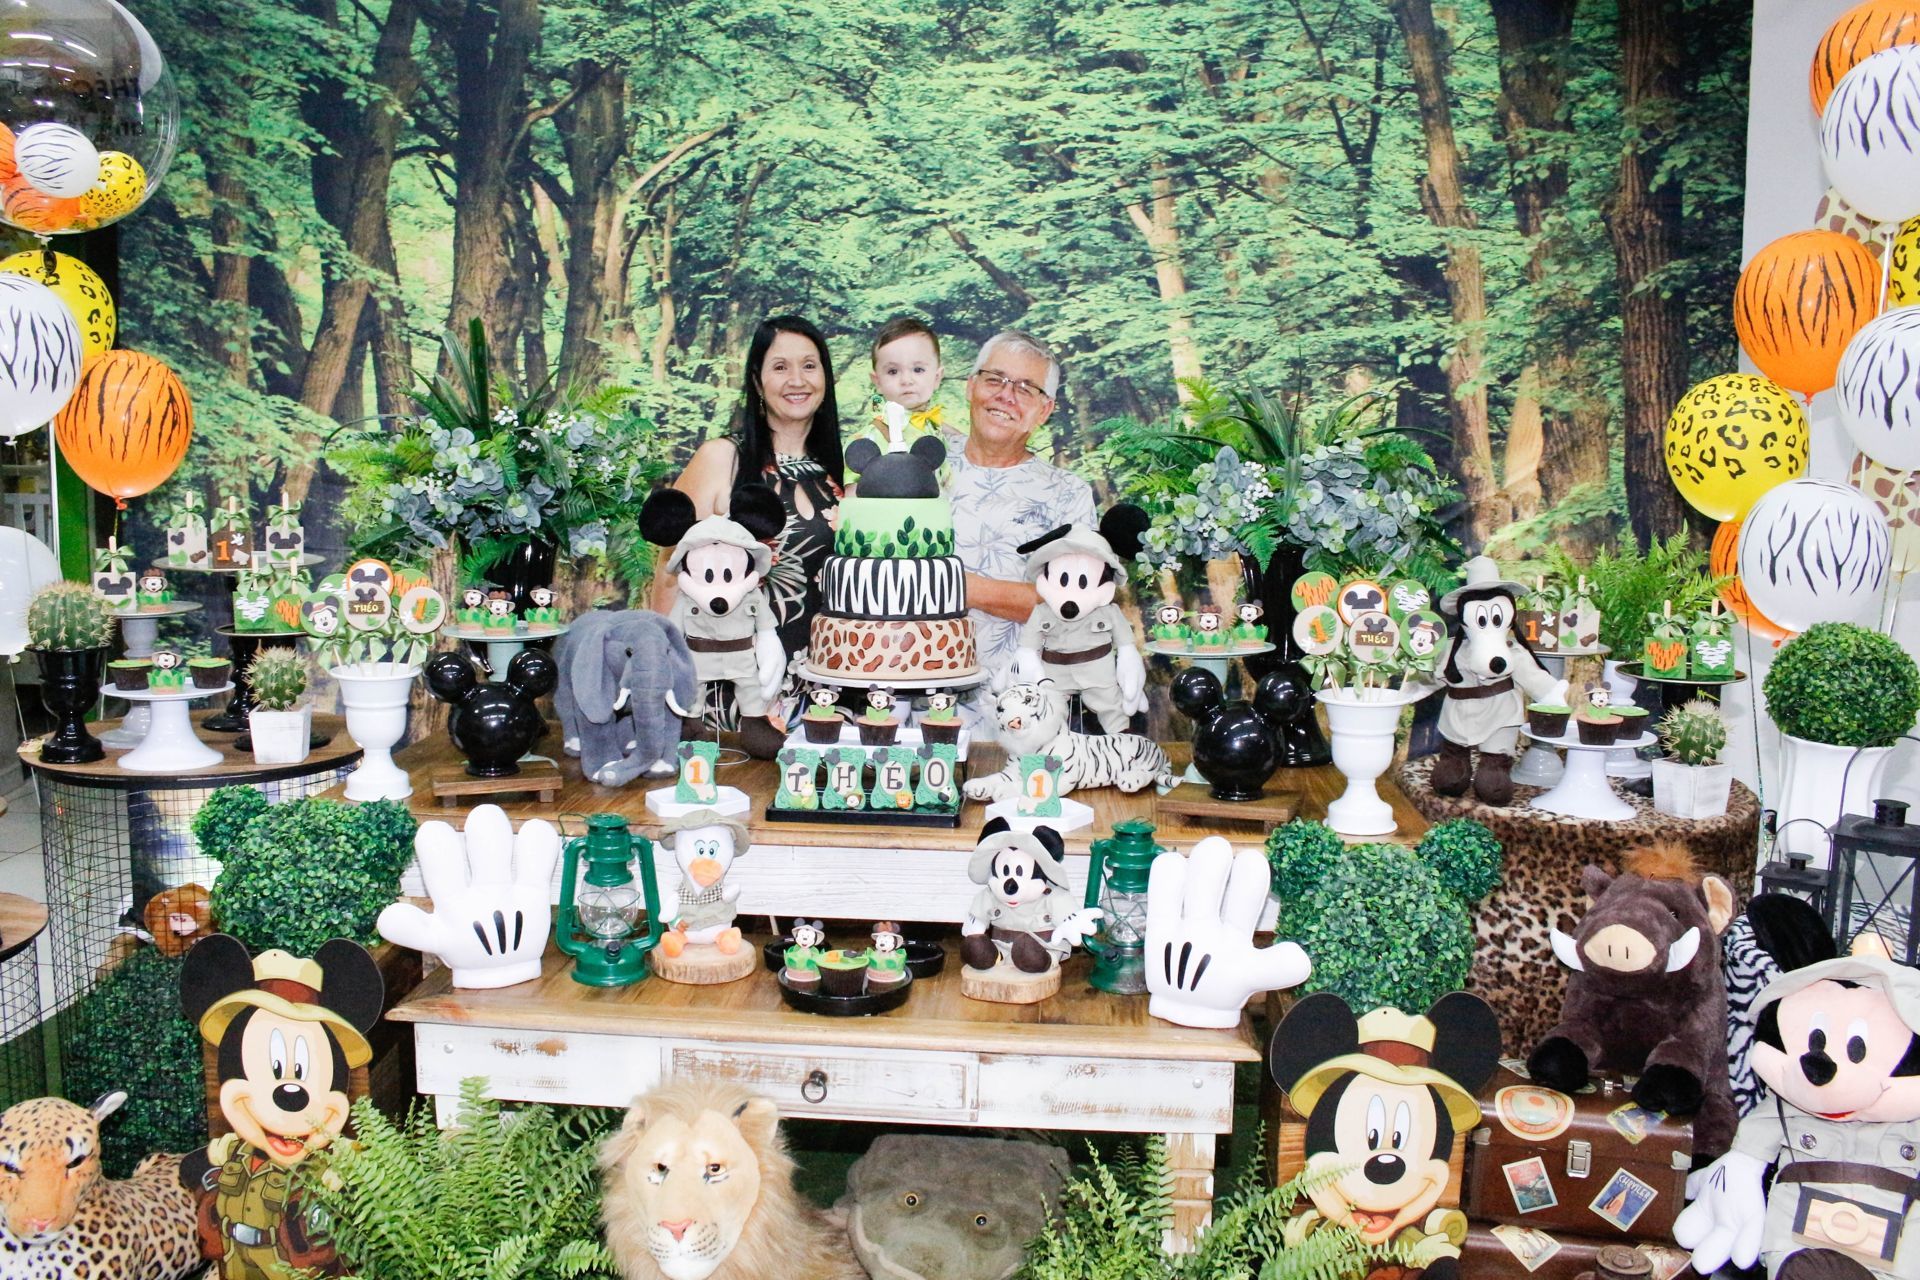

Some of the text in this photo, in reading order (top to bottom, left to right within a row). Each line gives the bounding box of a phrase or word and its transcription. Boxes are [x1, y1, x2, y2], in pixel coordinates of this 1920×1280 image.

[216, 540, 231, 561] 1
[354, 601, 379, 613] THÉO
[413, 597, 427, 620] 1
[1309, 616, 1328, 643] 1
[1361, 632, 1388, 644] THÉO
[1525, 620, 1539, 642] 1
[689, 761, 704, 784] 1
[1032, 775, 1046, 798] 1
